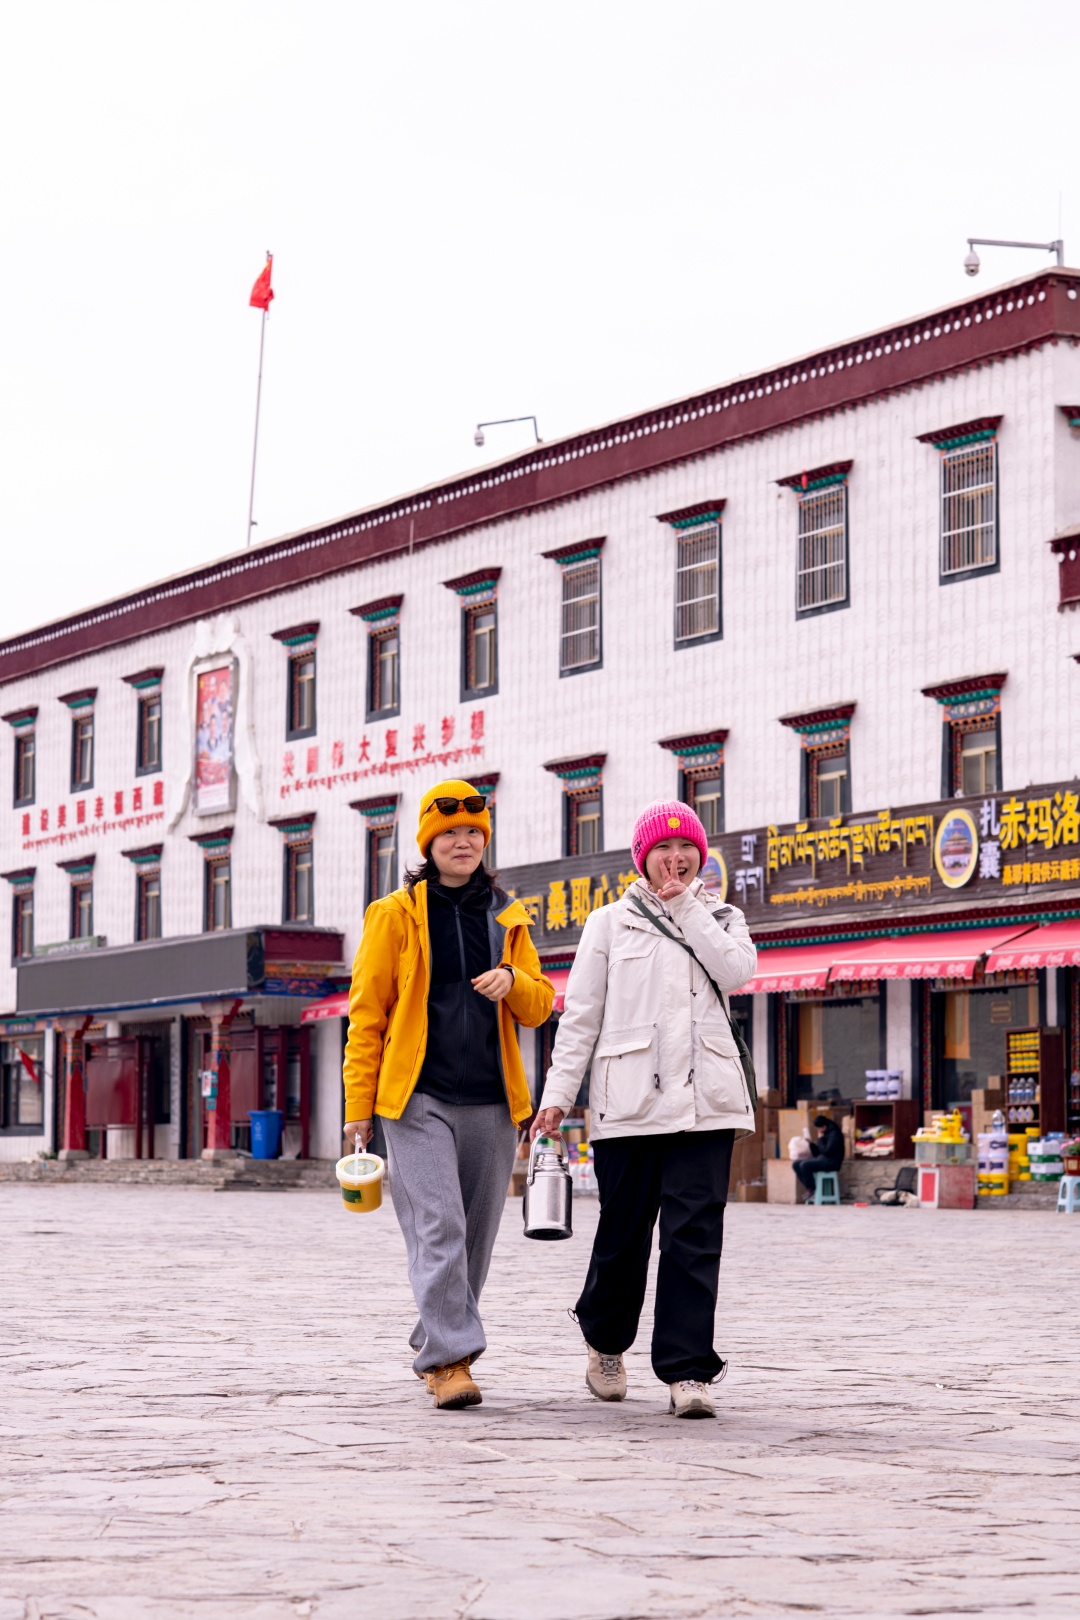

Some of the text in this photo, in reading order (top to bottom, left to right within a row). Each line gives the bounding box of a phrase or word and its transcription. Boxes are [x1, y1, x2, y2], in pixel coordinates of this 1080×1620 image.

[22, 780, 164, 836] 建设美丽幸福西藏
[998, 789, 1080, 851] 赤玛洛
